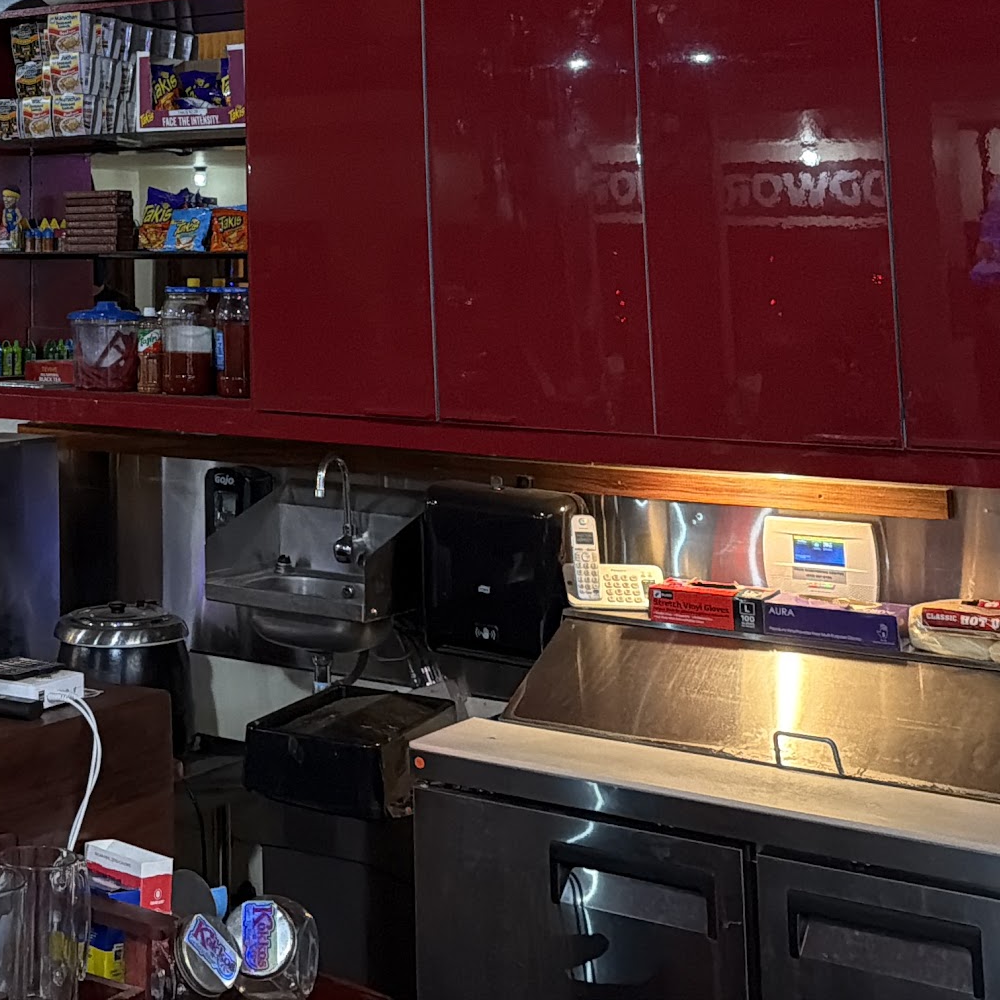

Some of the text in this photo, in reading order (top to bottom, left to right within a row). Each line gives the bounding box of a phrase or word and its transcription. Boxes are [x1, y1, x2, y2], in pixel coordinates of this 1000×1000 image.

[228, 105, 245, 123] Takis
[162, 116, 177, 126] FACE
[178, 116, 190, 126] THE
[215, 473, 235, 485] GOJO
[653, 599, 683, 608] Stretch
[684, 602, 703, 611] Vinyl
[704, 604, 730, 614] Gloves
[744, 604, 751, 613] L
[768, 606, 796, 617] AURA
[925, 612, 958, 622] CLASSIC
[960, 614, 988, 628] HOT
